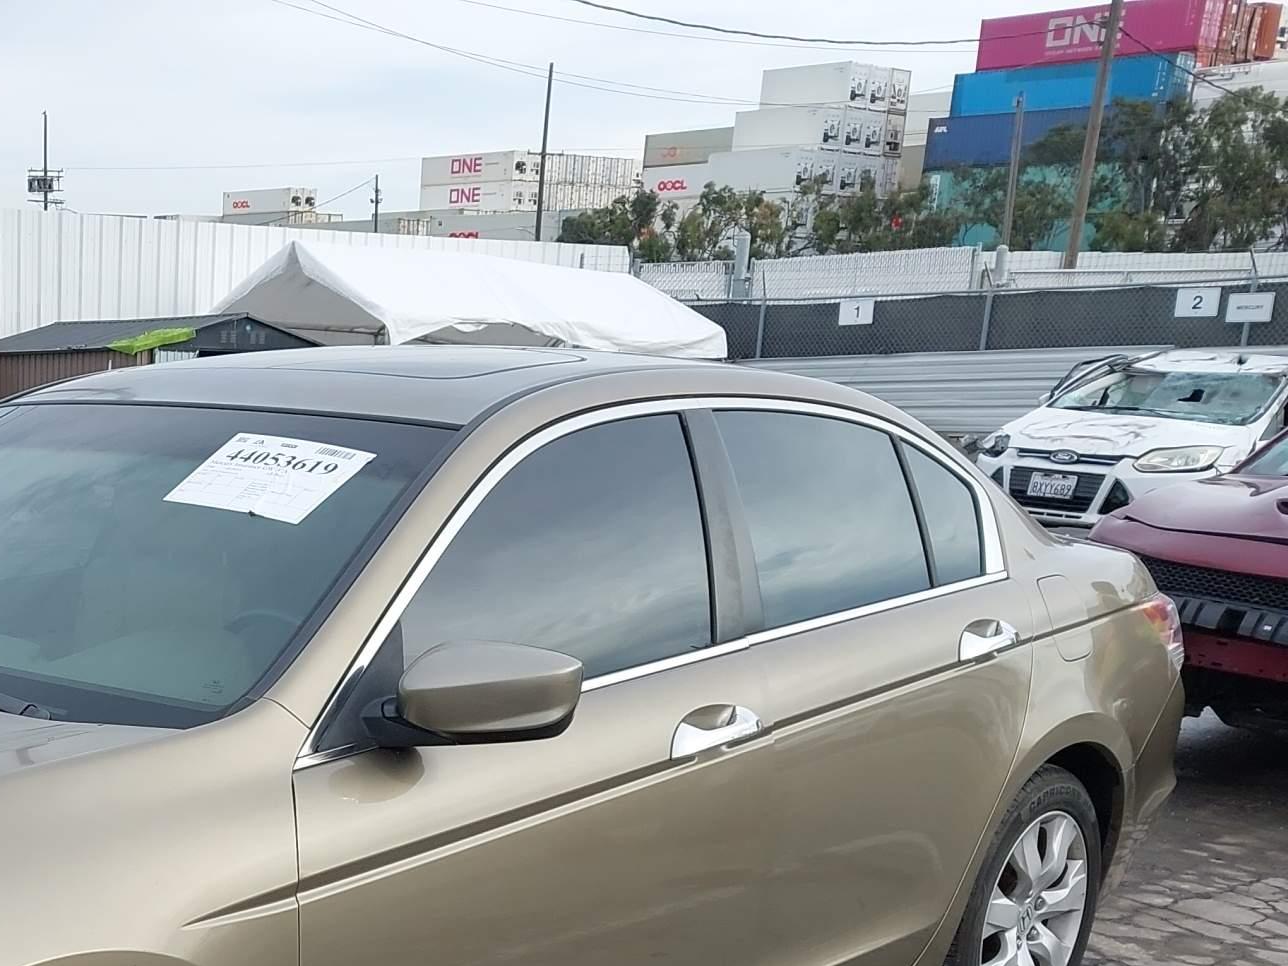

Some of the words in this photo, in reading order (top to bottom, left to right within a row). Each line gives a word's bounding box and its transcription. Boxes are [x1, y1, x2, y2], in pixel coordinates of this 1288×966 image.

[450, 157, 483, 175] ONE
[657, 180, 687, 191] OOCL
[449, 187, 481, 204] ONE
[1192, 295, 1203, 310] 2
[854, 305, 860, 318] 1
[226, 448, 339, 475] 44053619
